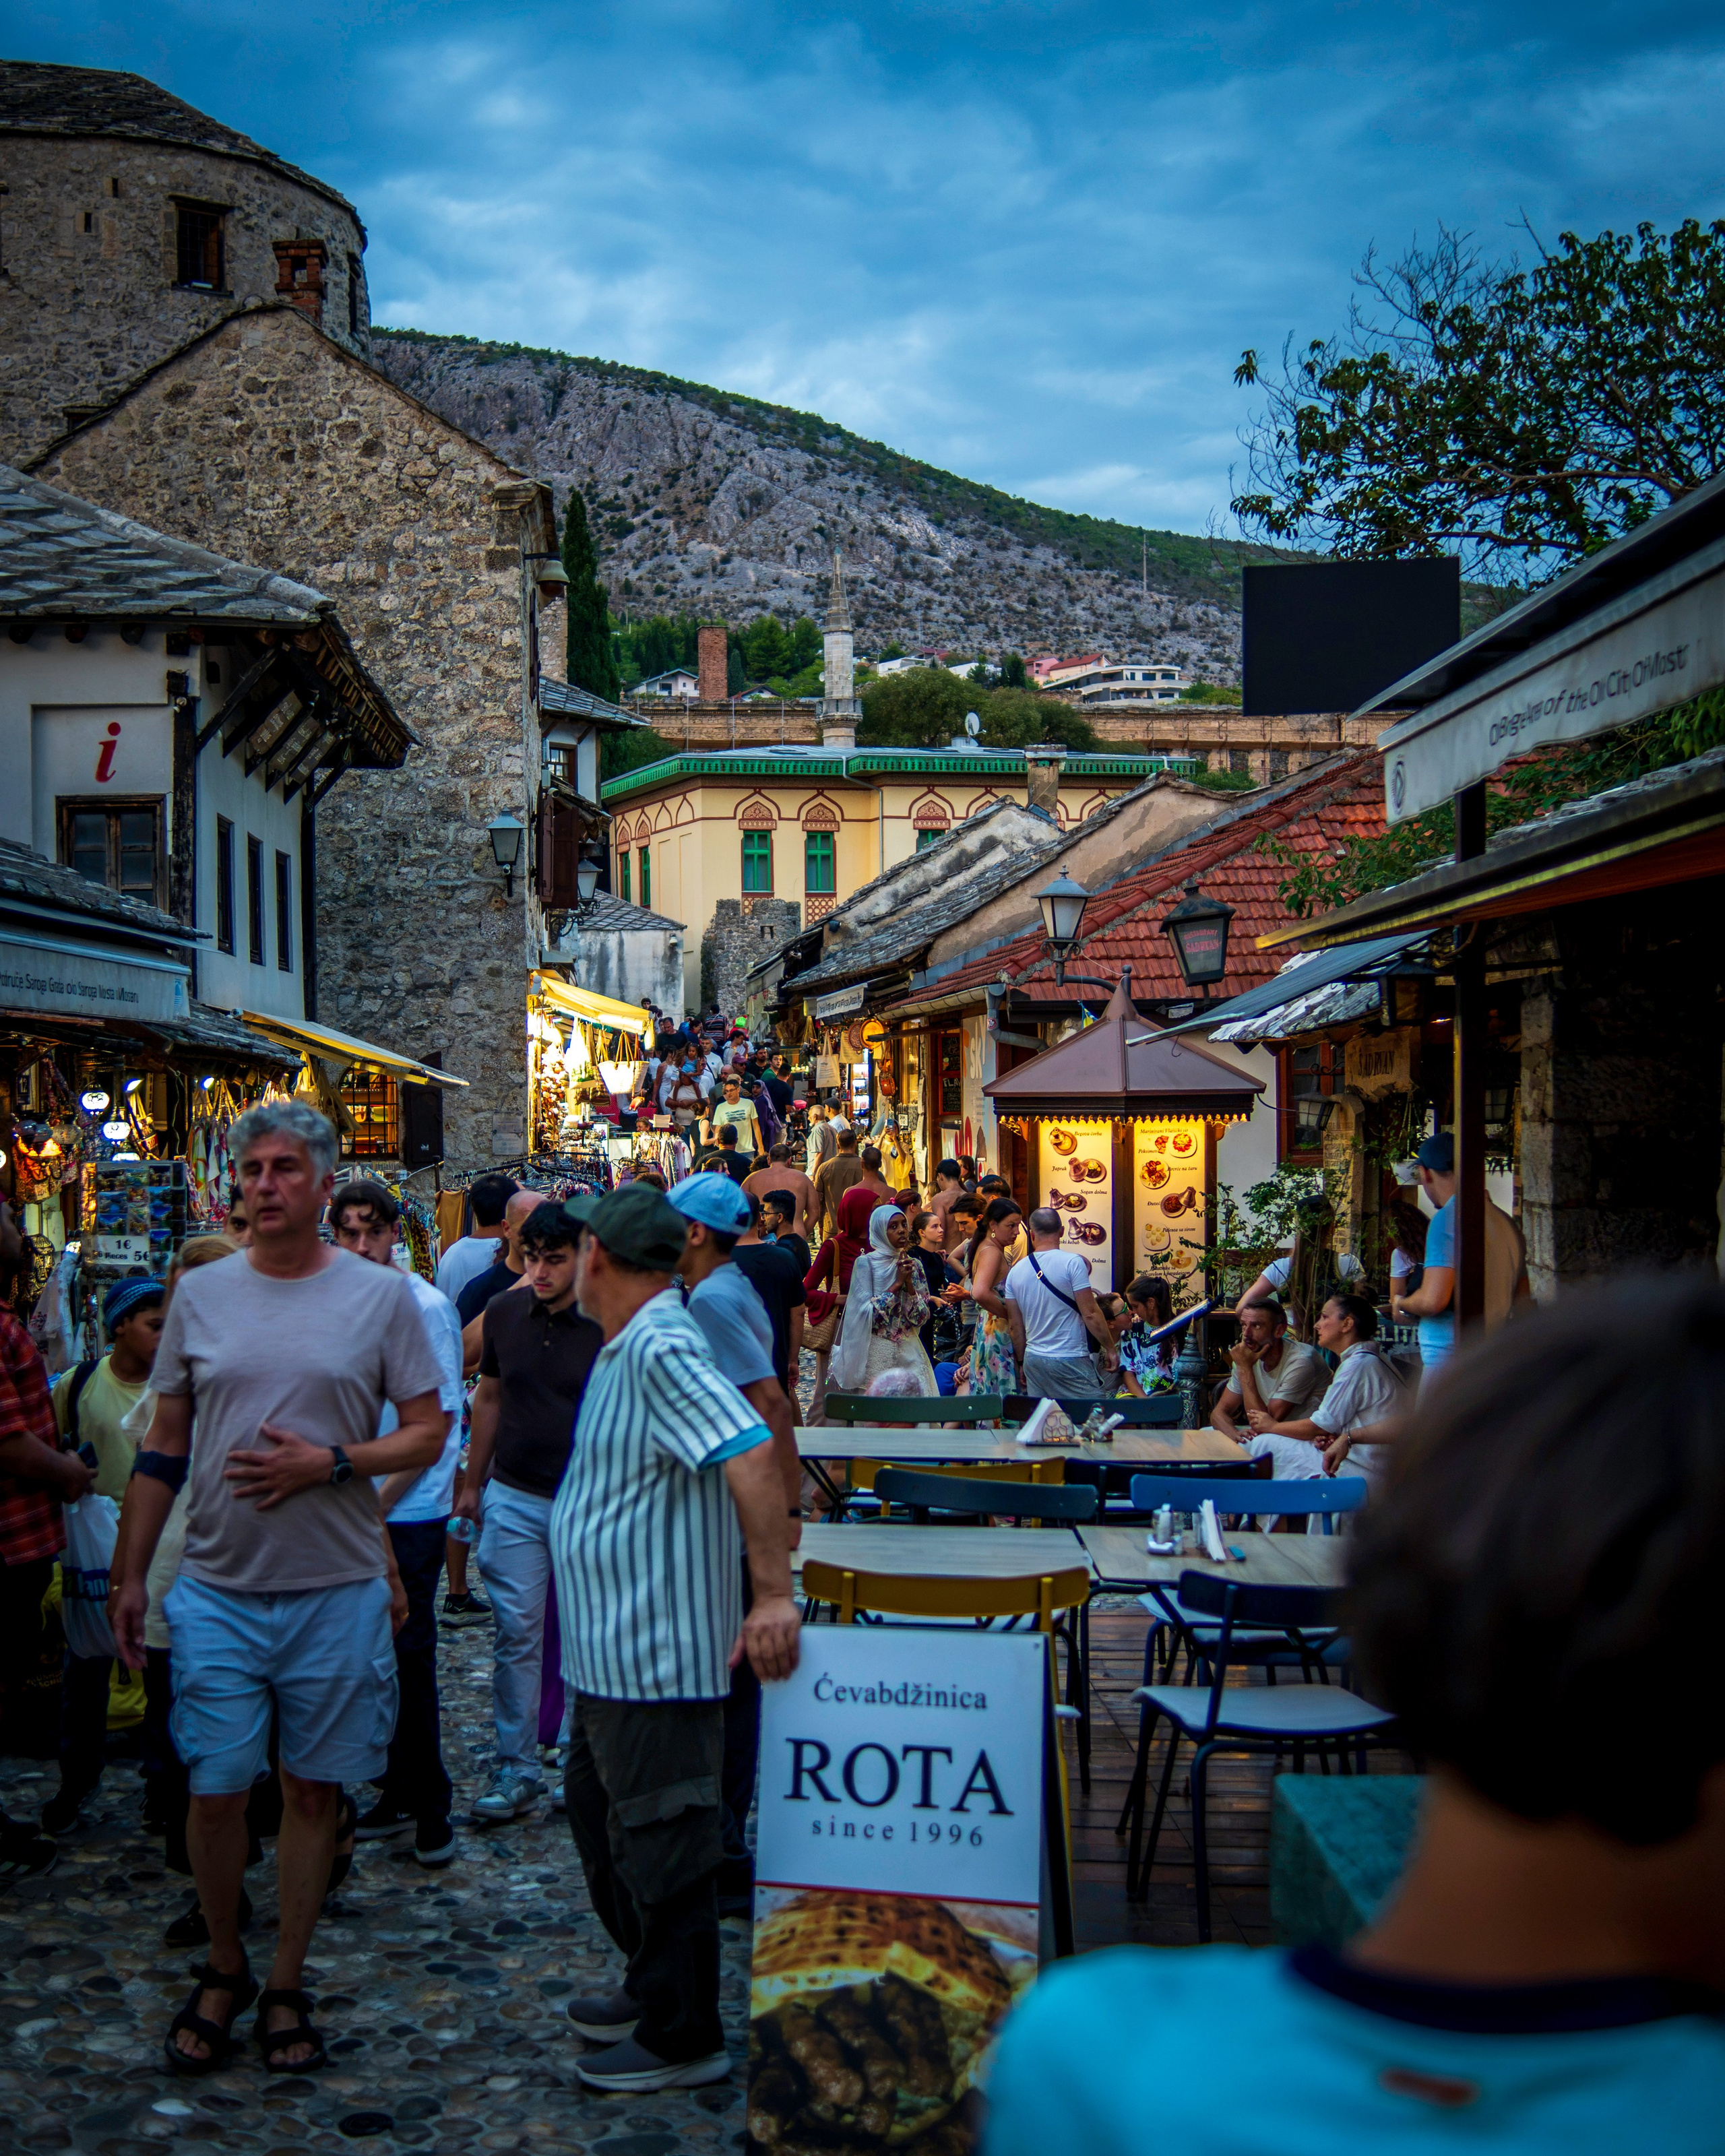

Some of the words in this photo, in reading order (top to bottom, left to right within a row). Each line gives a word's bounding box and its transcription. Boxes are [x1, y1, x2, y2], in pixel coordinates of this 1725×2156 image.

[814, 1672, 987, 1709] Ćevabdžinica
[783, 1738, 1014, 1816] ROTA
[812, 1815, 893, 1840] since
[910, 1821, 983, 1847] 1996
